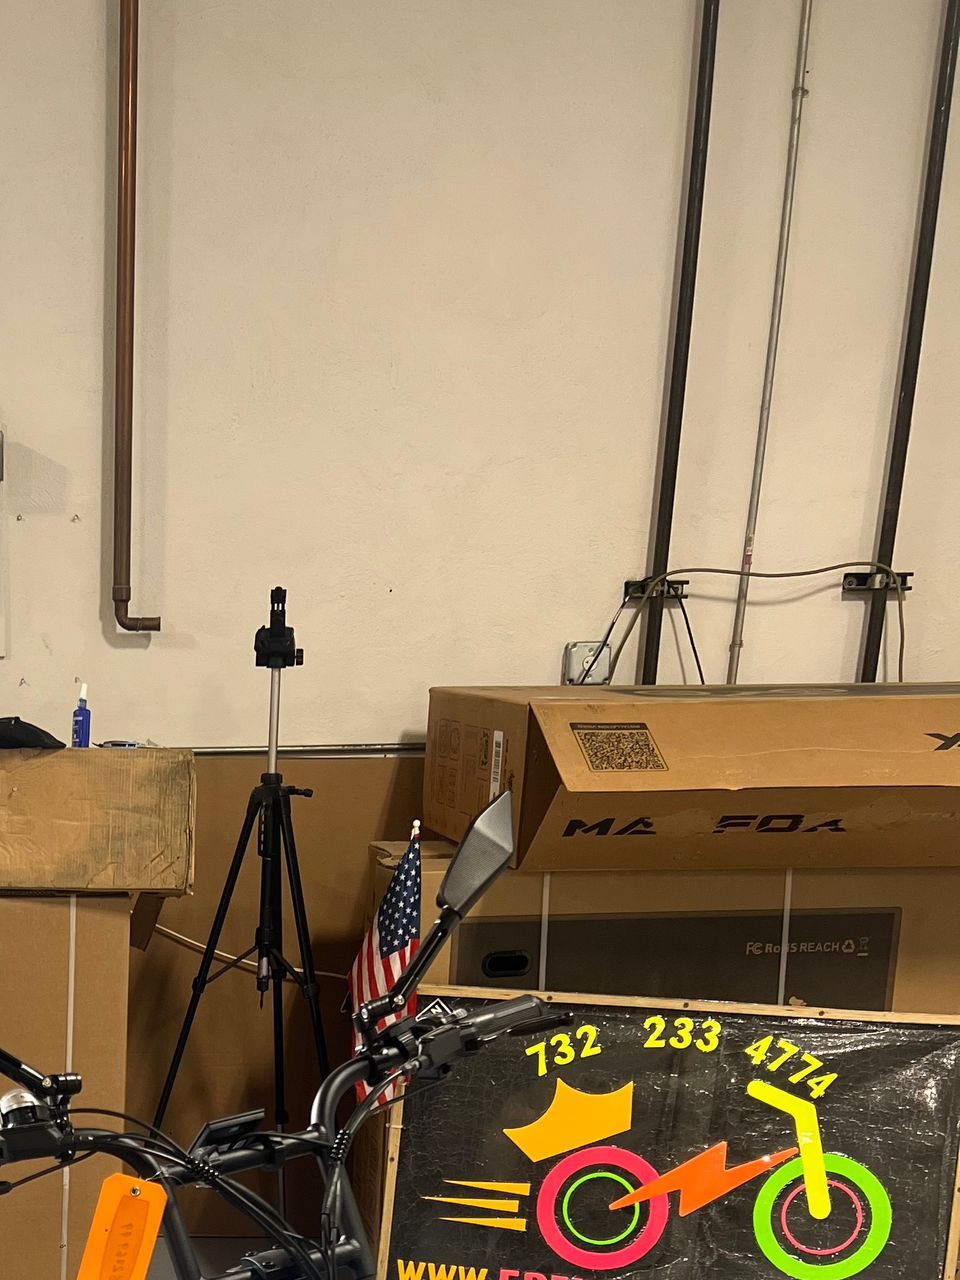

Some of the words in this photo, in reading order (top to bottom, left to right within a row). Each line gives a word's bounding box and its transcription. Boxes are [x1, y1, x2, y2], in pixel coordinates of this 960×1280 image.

[765, 943, 798, 954] RoS
[799, 942, 840, 952] REACH
[525, 1024, 603, 1078] 732
[642, 1016, 723, 1053] 233
[744, 1035, 839, 1101] 4774
